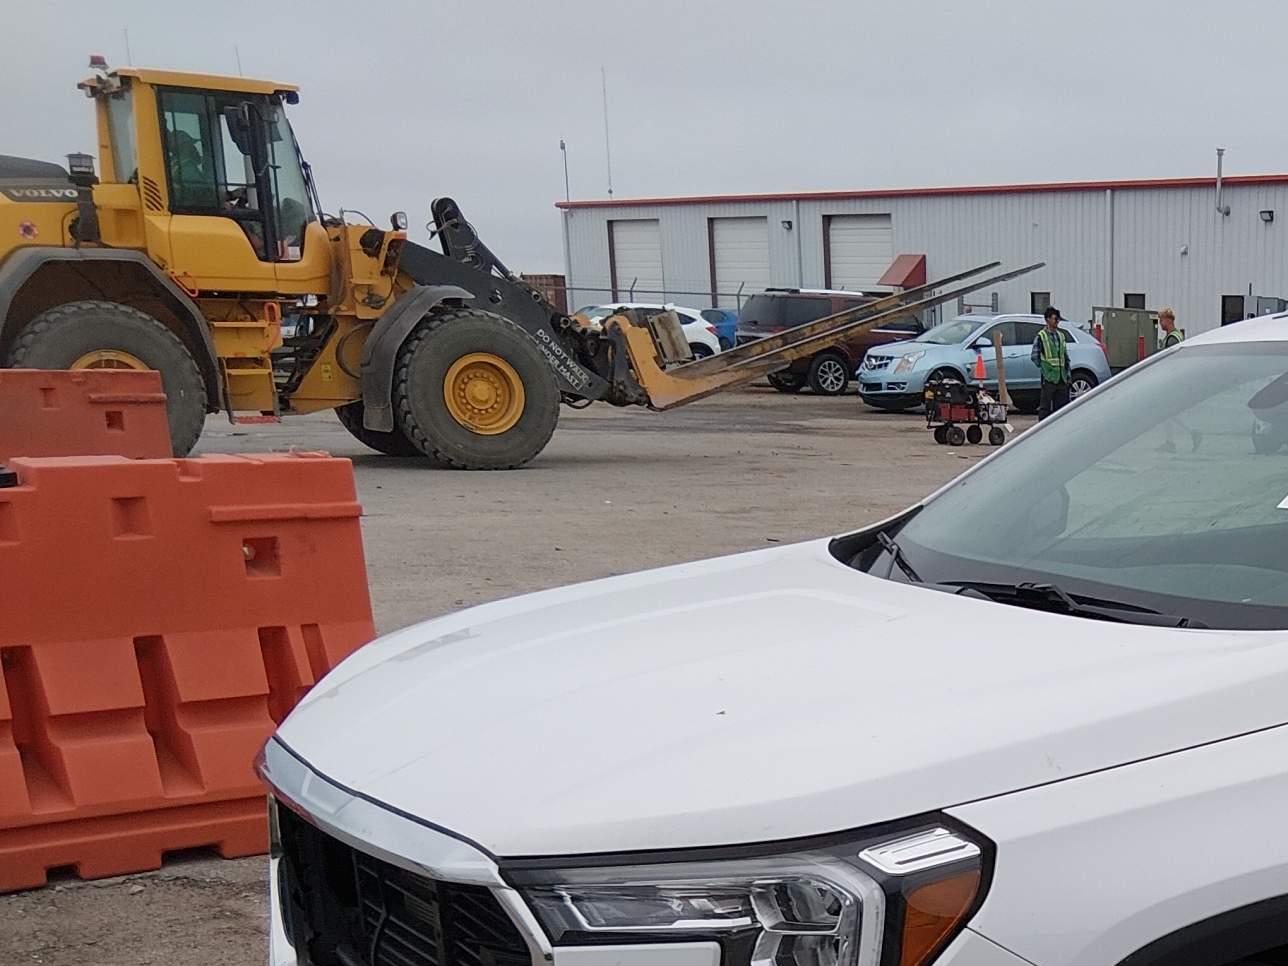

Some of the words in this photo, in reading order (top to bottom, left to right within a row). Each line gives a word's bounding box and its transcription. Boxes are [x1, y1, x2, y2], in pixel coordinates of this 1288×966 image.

[10, 189, 78, 198] VOLVO
[537, 328, 550, 343] DO
[549, 342, 568, 360] NOT
[566, 358, 590, 382] WALK
